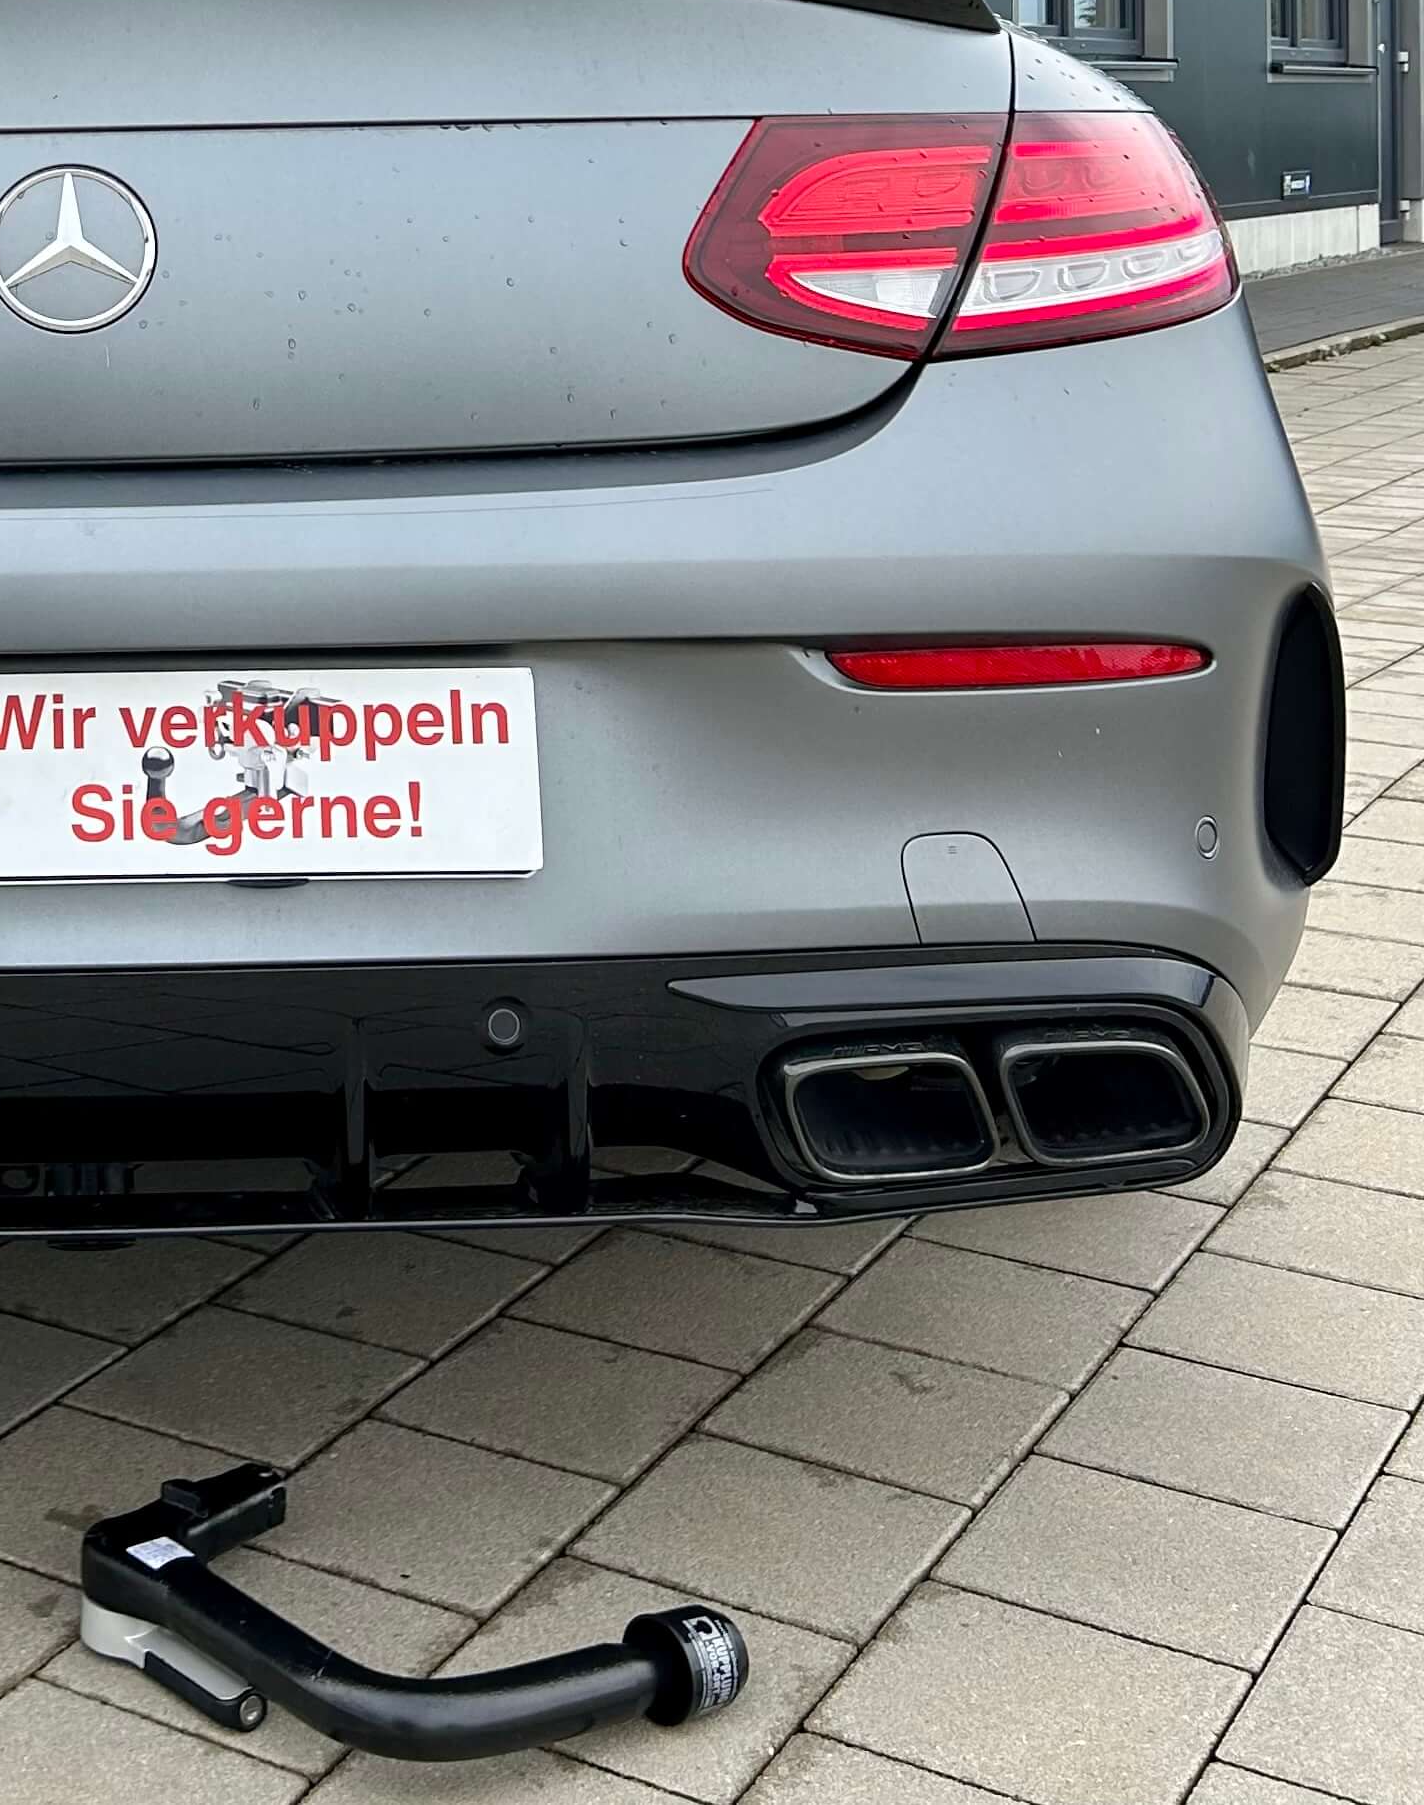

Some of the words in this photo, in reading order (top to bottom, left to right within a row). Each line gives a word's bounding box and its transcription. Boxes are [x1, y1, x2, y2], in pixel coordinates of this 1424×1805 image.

[119, 689, 510, 762] verkuppeln
[71, 783, 179, 843] Sie
[203, 781, 424, 856] gerne!
